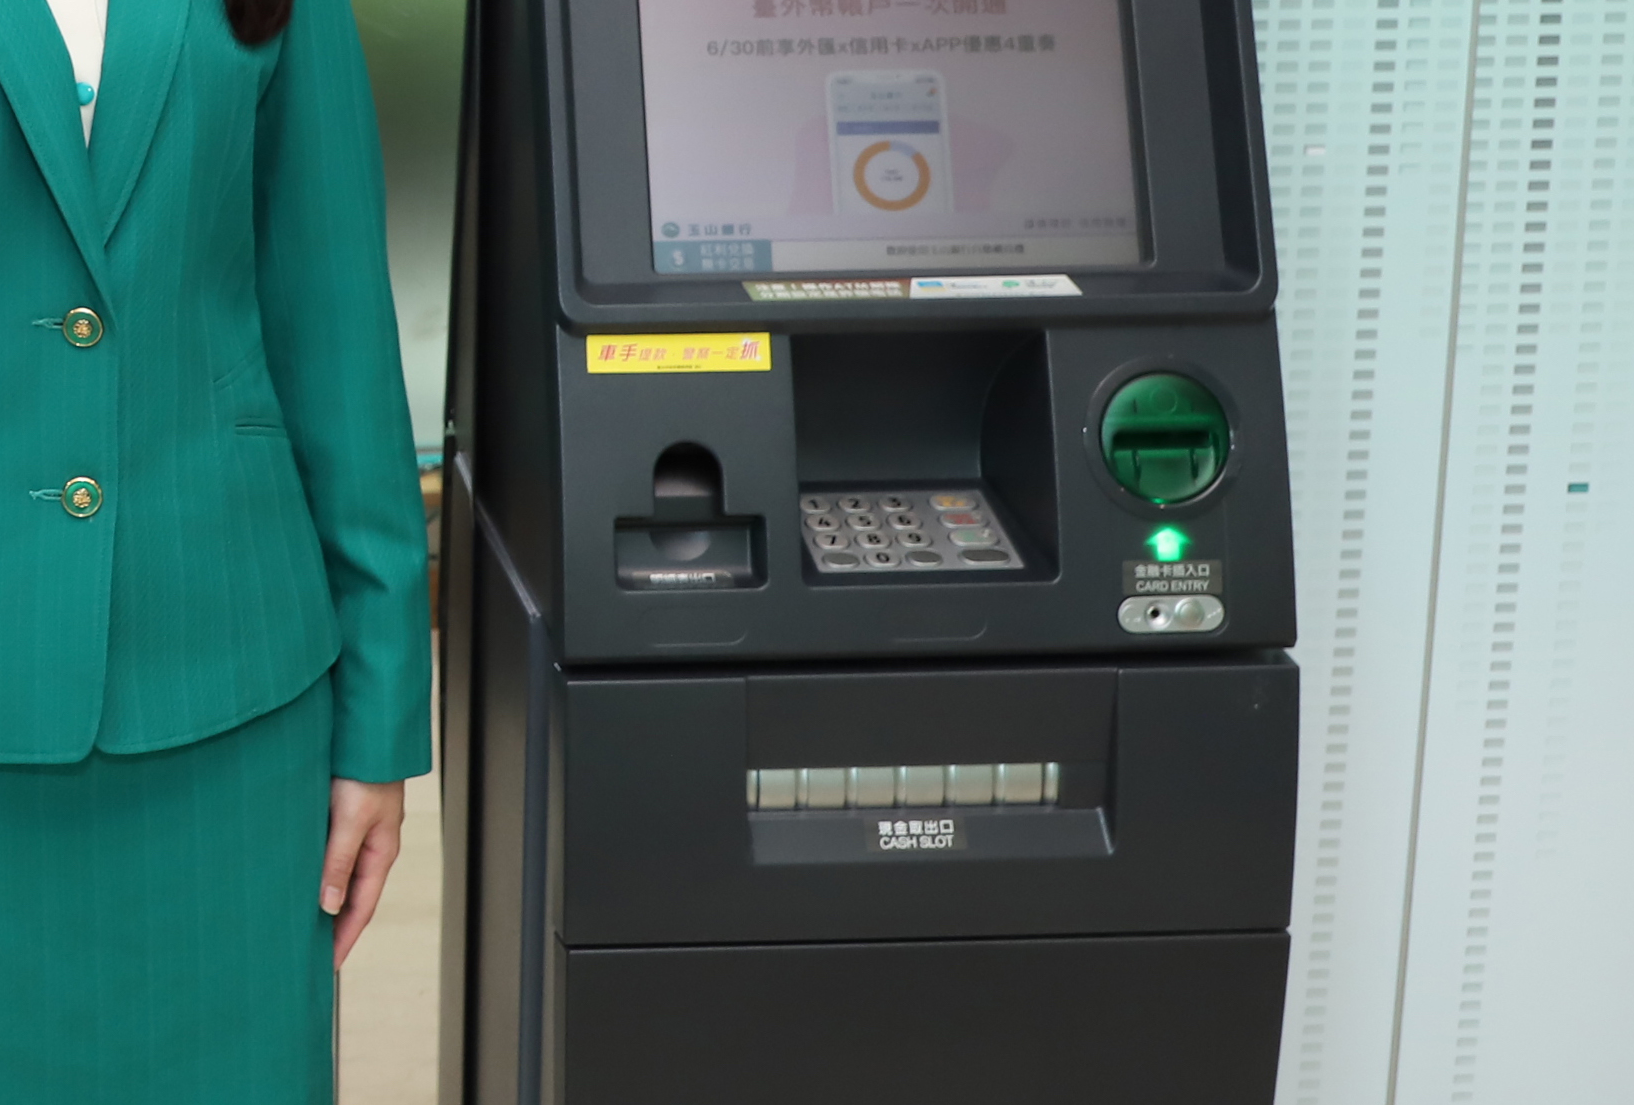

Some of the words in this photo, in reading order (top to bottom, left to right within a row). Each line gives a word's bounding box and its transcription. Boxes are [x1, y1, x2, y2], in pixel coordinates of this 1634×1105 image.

[1135, 580, 1170, 593] CARD
[1170, 579, 1210, 592] ENTRY
[878, 819, 954, 835] 現金取出口
[879, 836, 917, 850] CASH
[919, 835, 954, 849] SLOT
